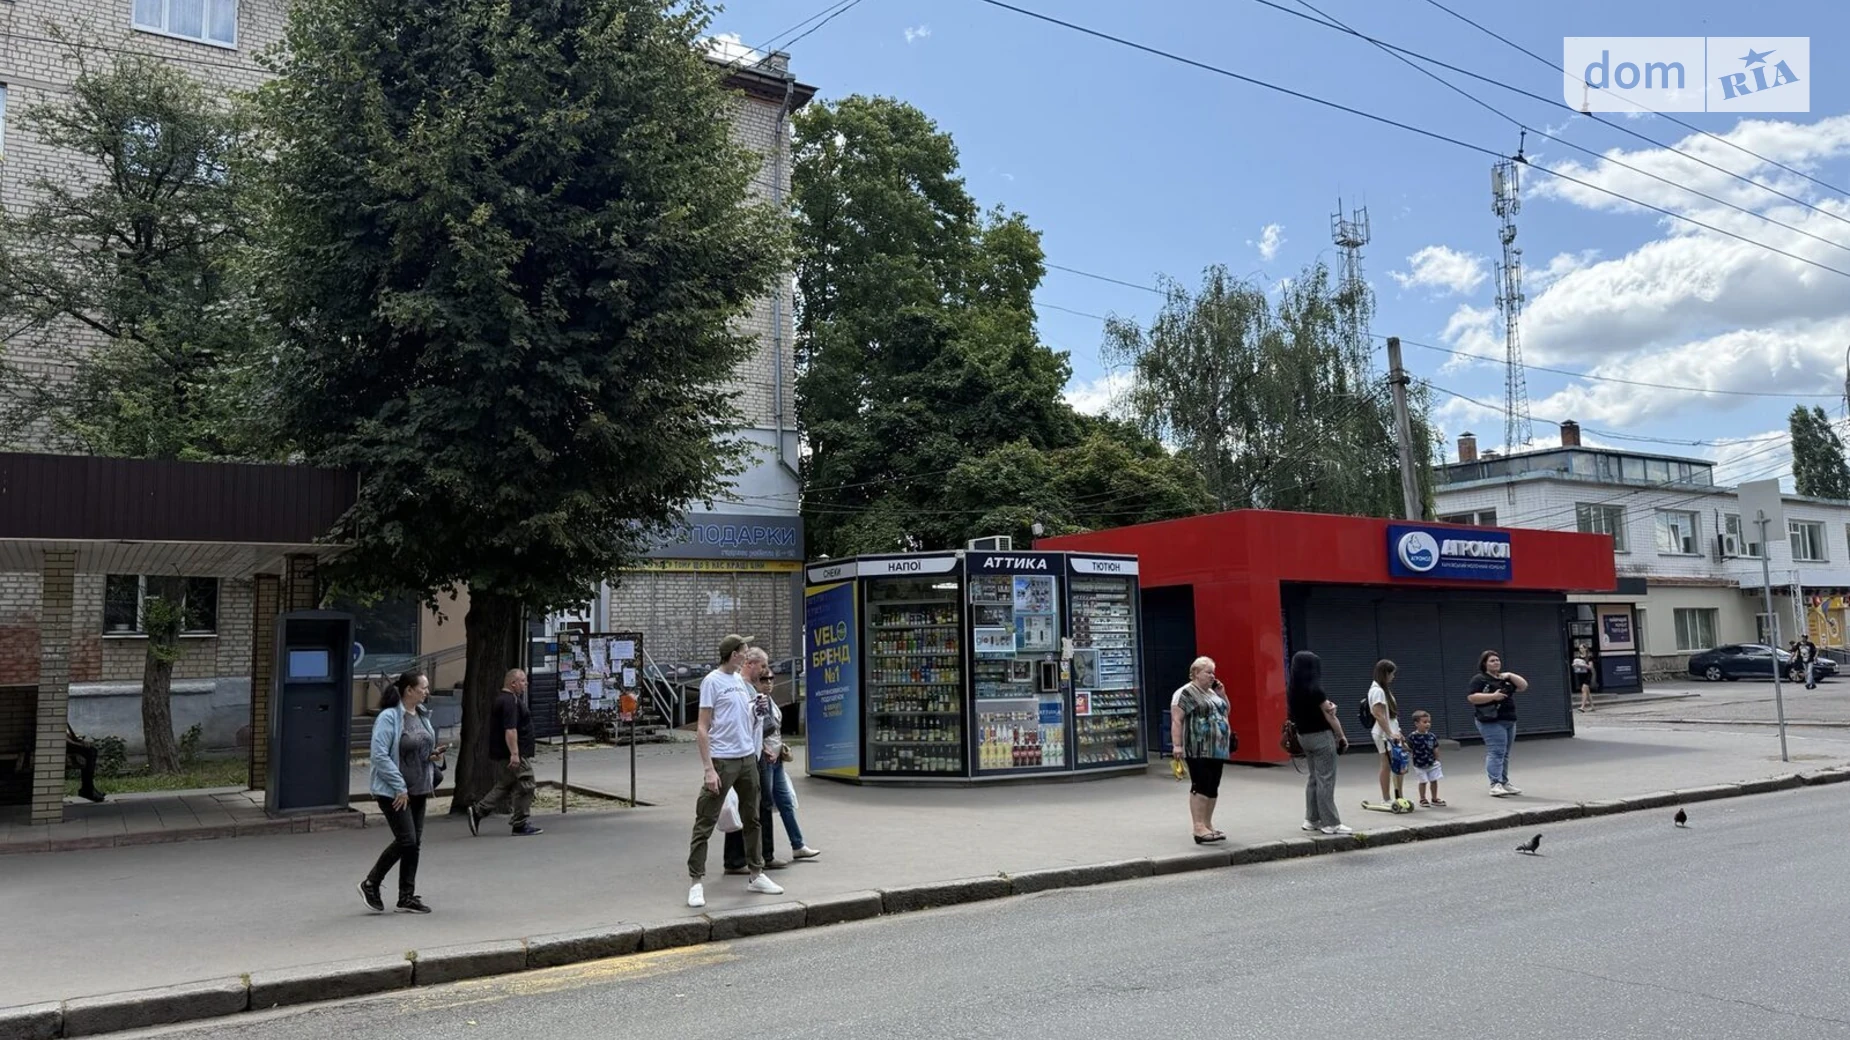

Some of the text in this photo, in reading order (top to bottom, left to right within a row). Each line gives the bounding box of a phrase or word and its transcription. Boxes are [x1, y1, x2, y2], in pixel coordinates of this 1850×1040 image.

[888, 560, 921, 572] НАПОЇ
[983, 557, 1048, 570] АТТИКА
[1092, 561, 1121, 572] ТЮТЮН
[823, 568, 841, 579] СНЕКИ
[814, 621, 848, 647] VELO
[812, 644, 851, 668] БРЕНД
[824, 665, 840, 684] №1
